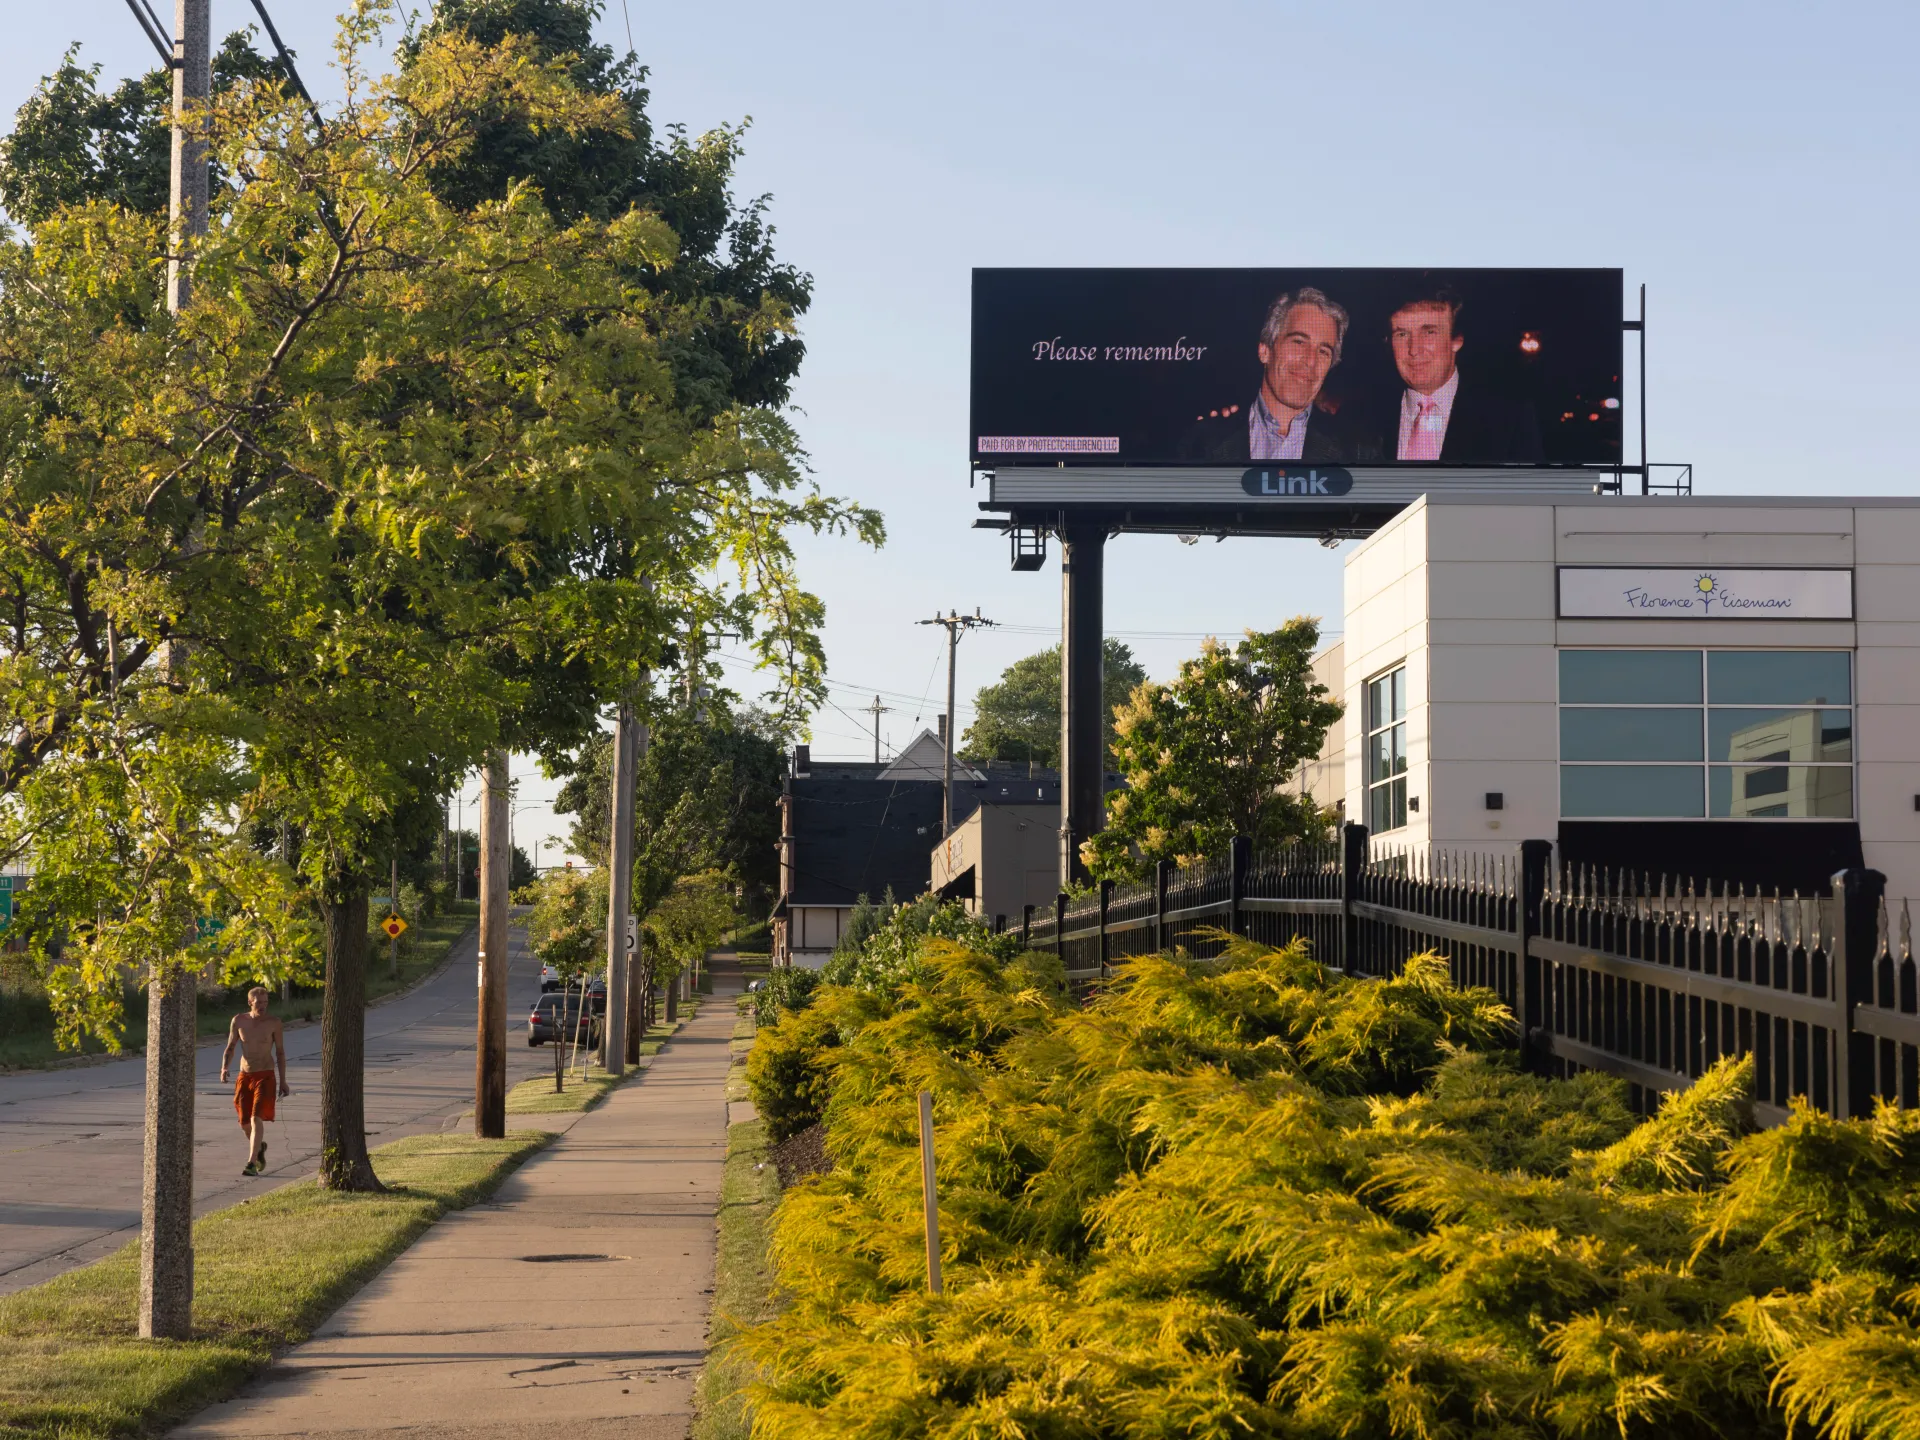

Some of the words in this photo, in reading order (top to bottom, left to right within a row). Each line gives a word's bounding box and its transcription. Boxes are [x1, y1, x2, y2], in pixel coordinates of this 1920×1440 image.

[1032, 336, 1097, 361] Please
[1104, 336, 1208, 361] remember
[981, 438, 999, 451] PAID
[1001, 438, 1015, 451] FOR
[1018, 438, 1027, 451] BY
[1104, 438, 1118, 451] LLC
[1261, 469, 1329, 494] Link
[1623, 587, 1694, 608] Florence
[1719, 588, 1792, 608] Eiseman
